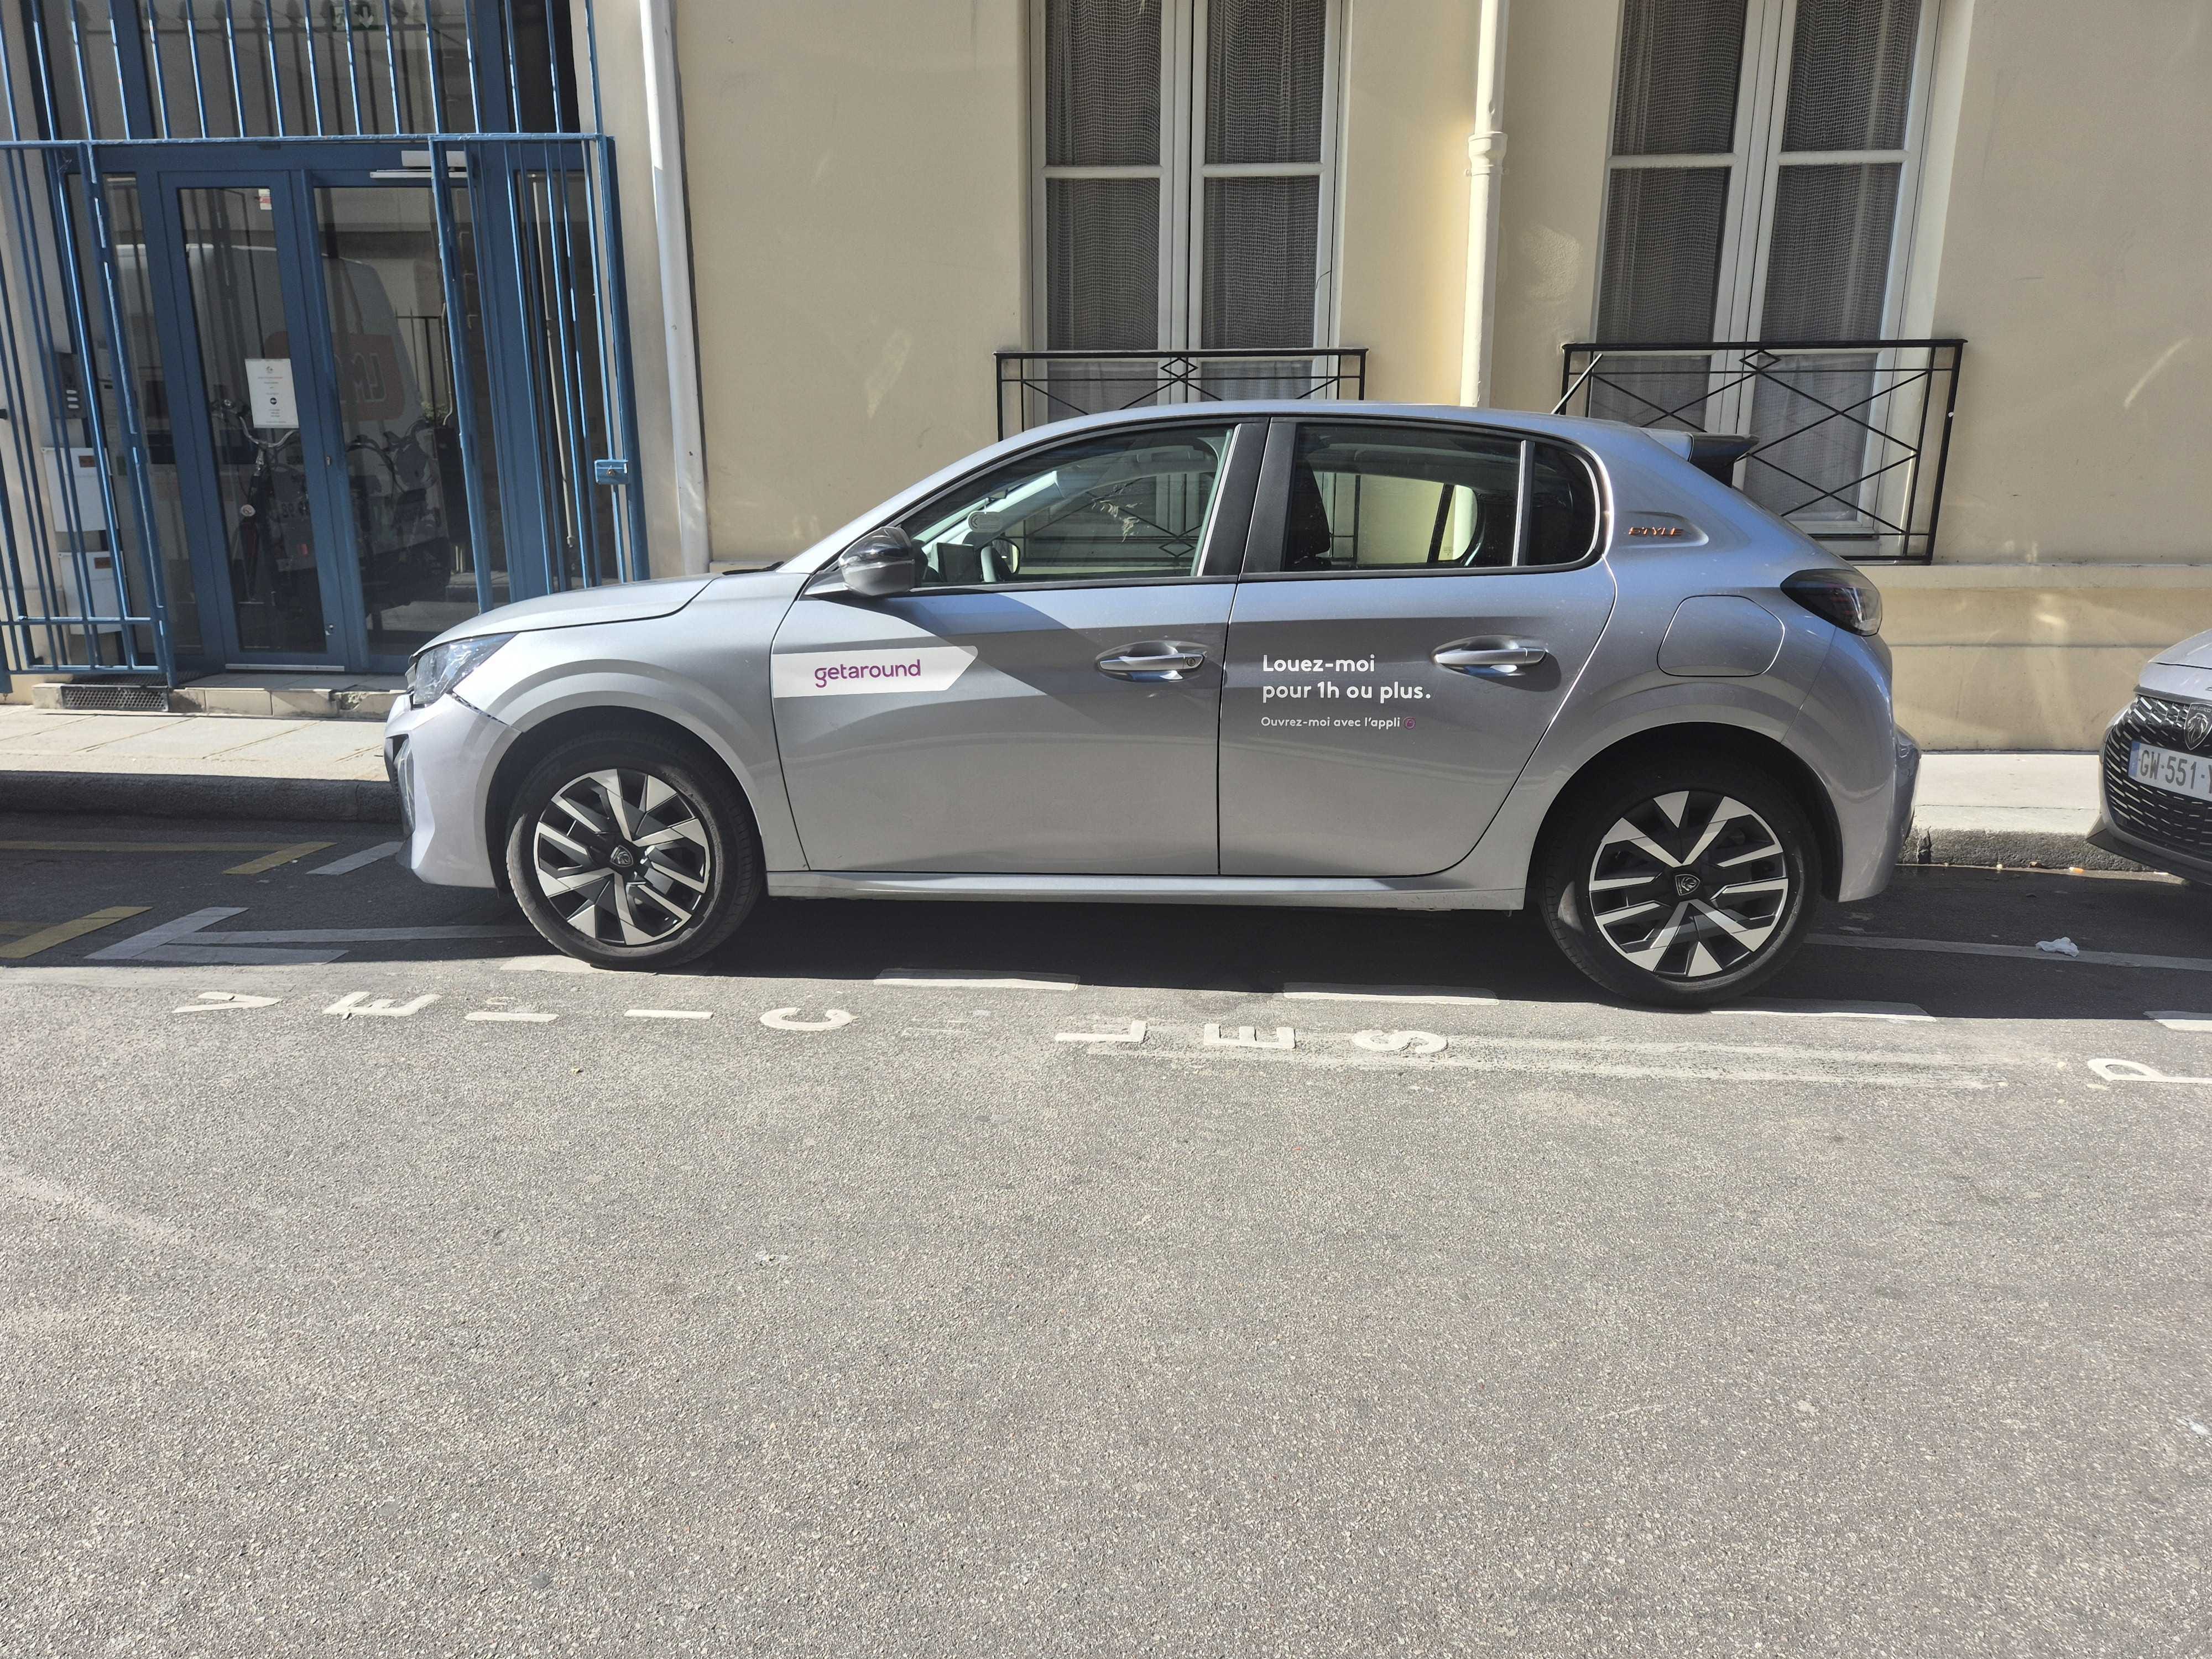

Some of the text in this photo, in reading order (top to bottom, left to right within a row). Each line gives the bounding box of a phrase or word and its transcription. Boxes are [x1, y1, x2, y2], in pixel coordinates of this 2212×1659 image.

[1263, 654, 1375, 672] Louez-moi
[814, 659, 921, 688] getaround
[1262, 681, 1432, 703] pour 1h ou plus.
[1261, 717, 1330, 727] Ouvrez-moi
